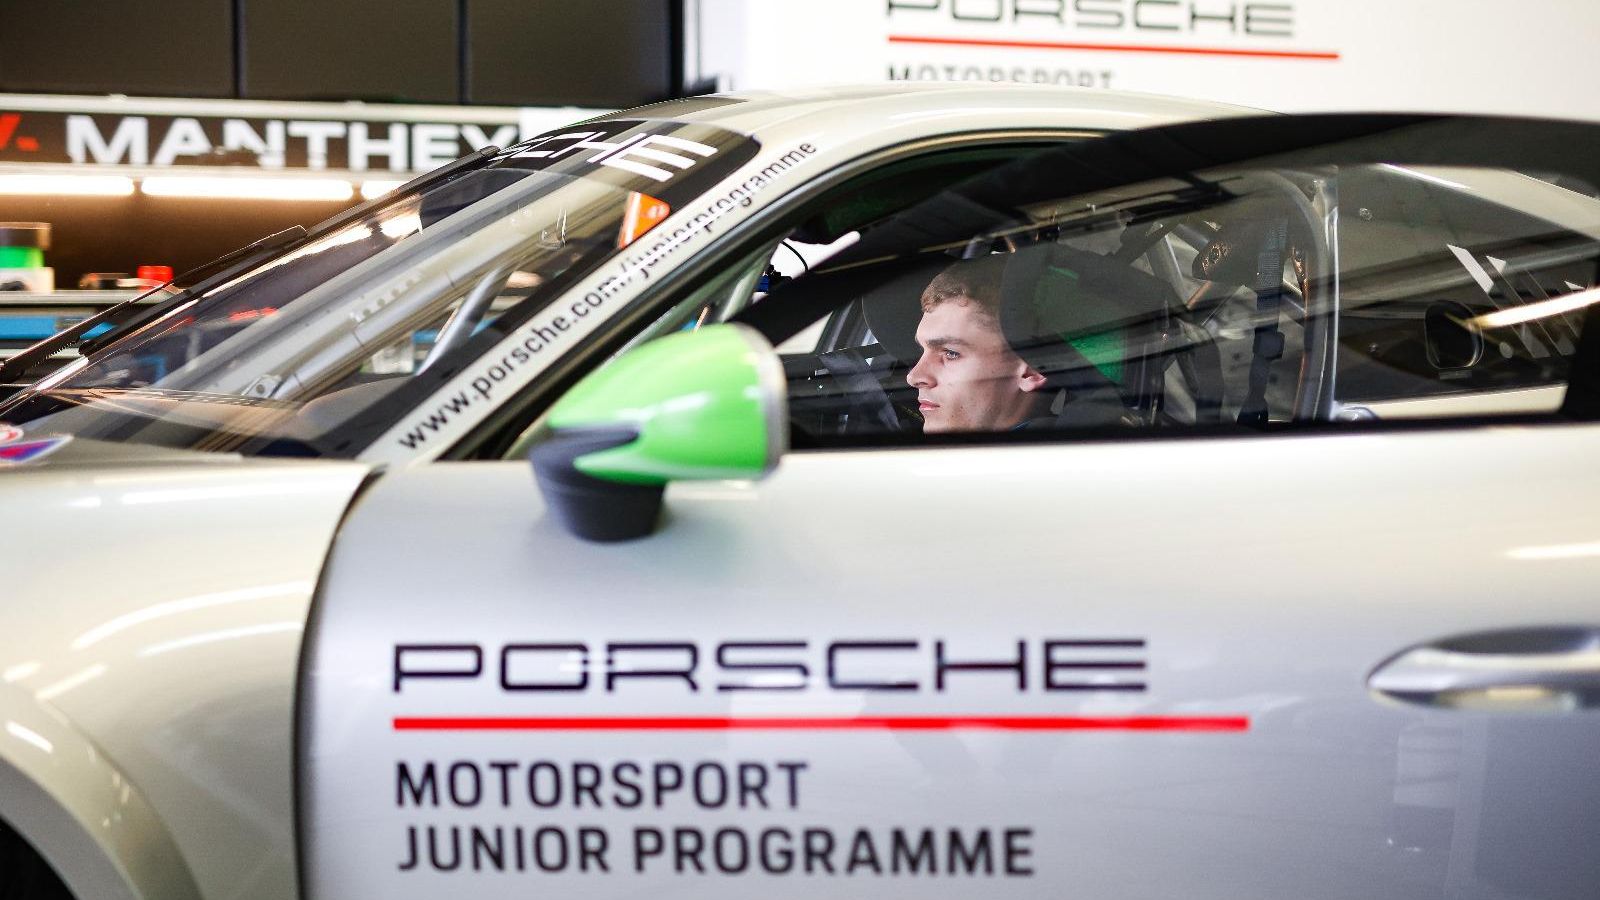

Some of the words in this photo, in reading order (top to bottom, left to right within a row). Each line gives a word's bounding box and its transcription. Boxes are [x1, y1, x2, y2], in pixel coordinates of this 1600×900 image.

[66, 115, 519, 171] MANTHEY
[393, 640, 1147, 692] PORSCHE
[396, 762, 808, 808] MOTORSPORT
[398, 826, 611, 872] JUNIOR
[634, 828, 1034, 875] PROGRAMME
